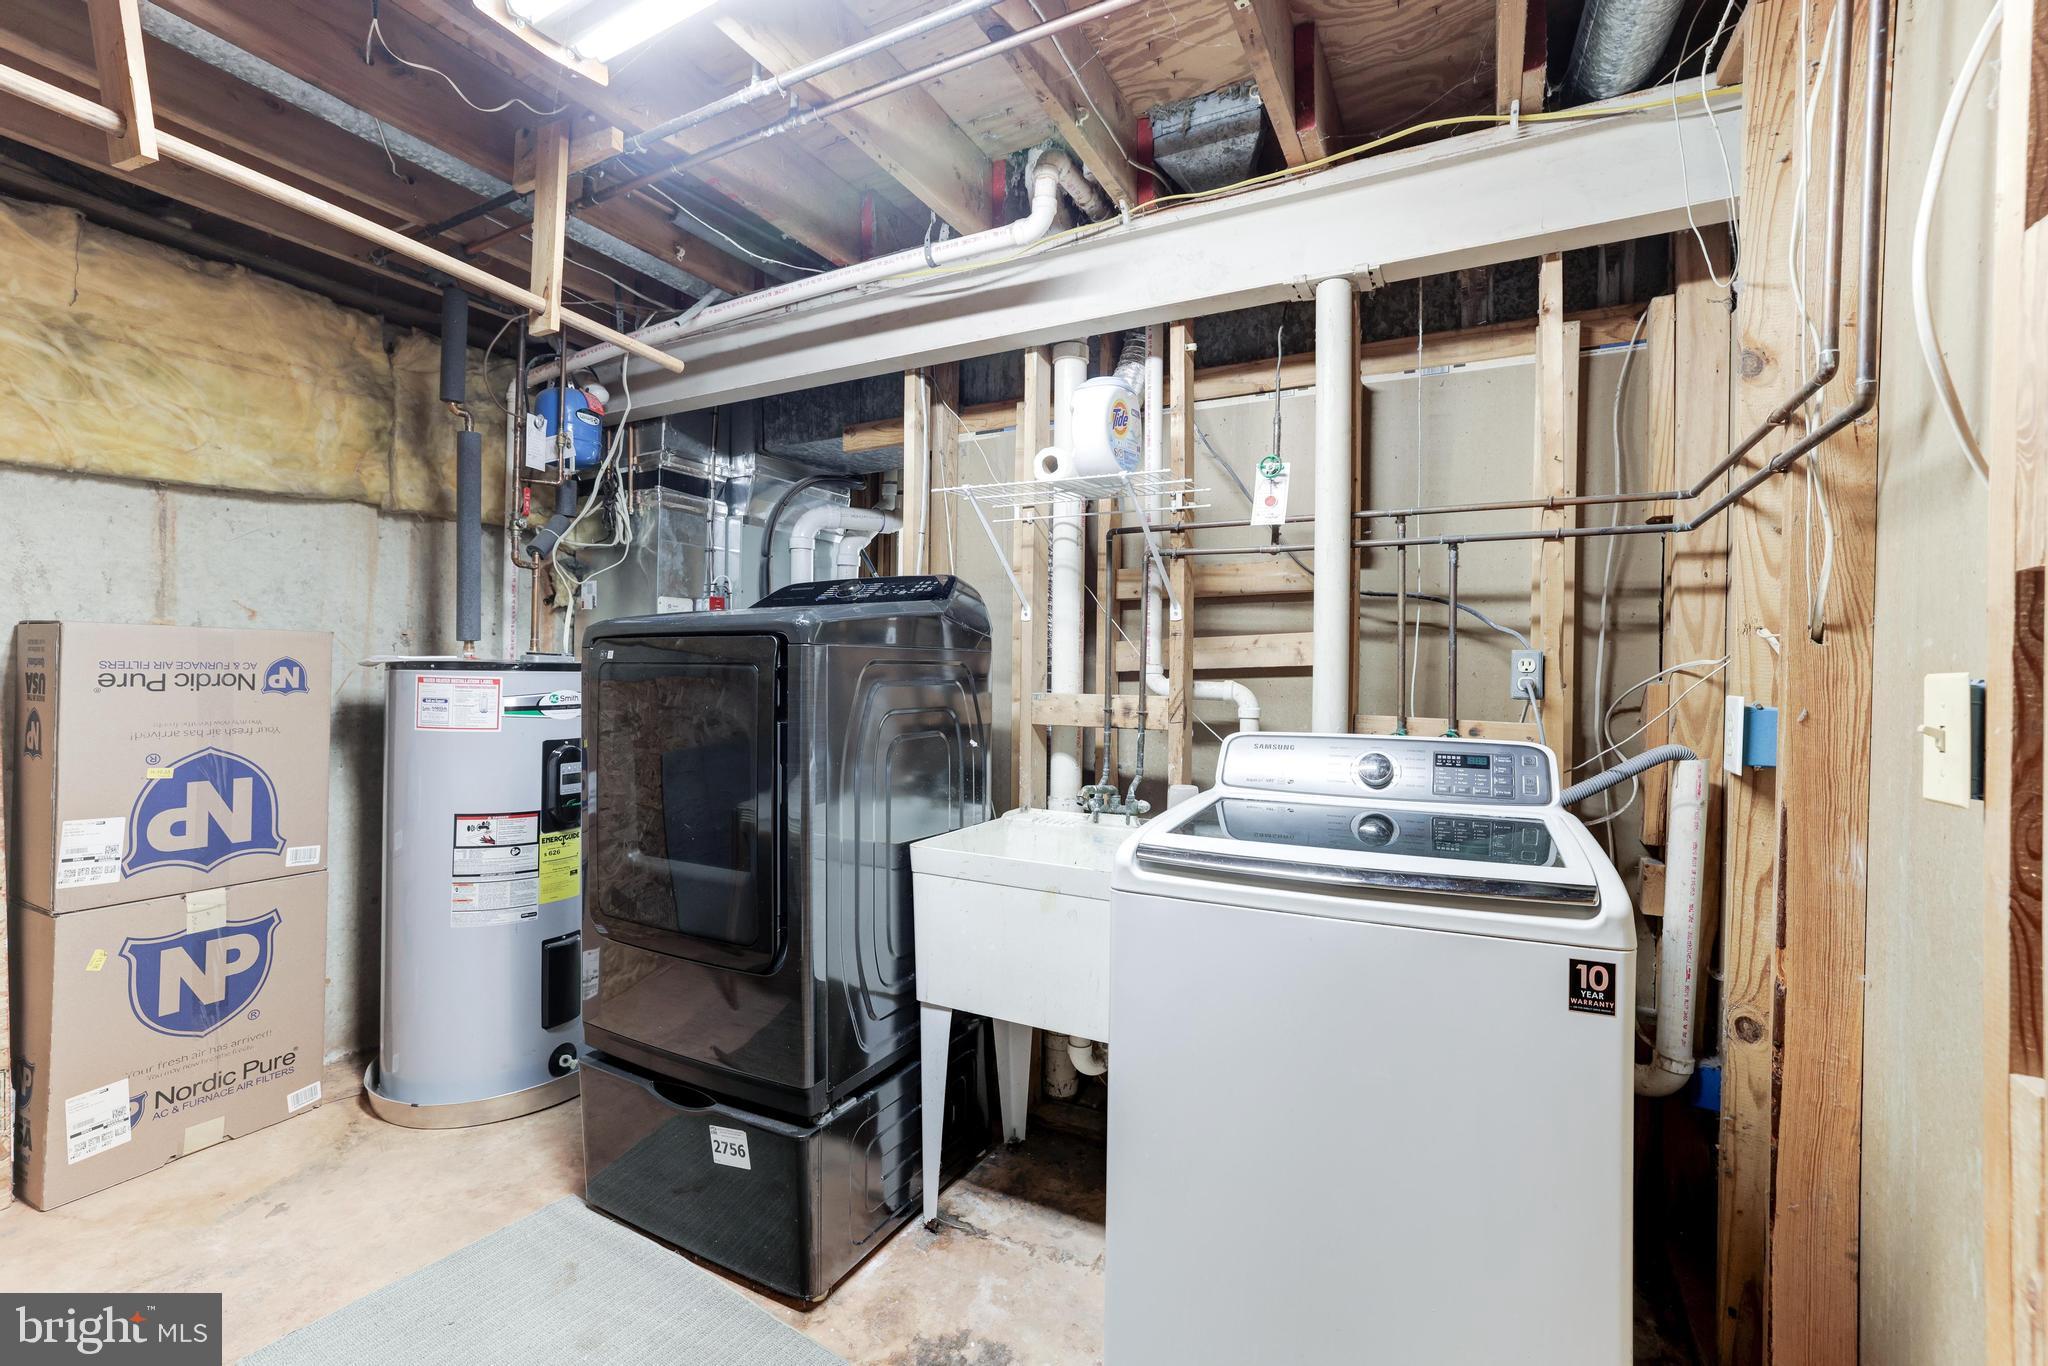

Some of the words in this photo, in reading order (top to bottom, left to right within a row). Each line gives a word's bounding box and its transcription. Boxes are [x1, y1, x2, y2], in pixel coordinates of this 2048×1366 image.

[1112, 408, 1128, 429] Tide
[99, 660, 150, 670] FILTERS
[153, 661, 174, 670] AIR
[176, 661, 230, 670] FURNACE
[243, 662, 258, 671] AC
[25, 672, 46, 695] USA
[97, 673, 166, 692] Pure
[174, 673, 256, 692] Nordic
[268, 666, 300, 689] NP
[1253, 743, 1295, 751] SAMSUNG
[146, 777, 253, 852] NP
[158, 933, 260, 1018] NP
[1576, 963, 1609, 992] 10
[1570, 997, 1615, 1009] WARRANTY
[1580, 990, 1605, 1000] YEAR
[158, 1054, 188, 1069] fresh
[154, 1070, 236, 1109] Nordic
[243, 1052, 296, 1079] Pure
[152, 1108, 169, 1121] AC
[171, 1106, 180, 1114] &
[182, 1087, 234, 1110] FURNACE
[235, 1080, 254, 1092] AIR
[255, 1066, 295, 1086] FILTERS
[713, 1139, 746, 1158] 2756
